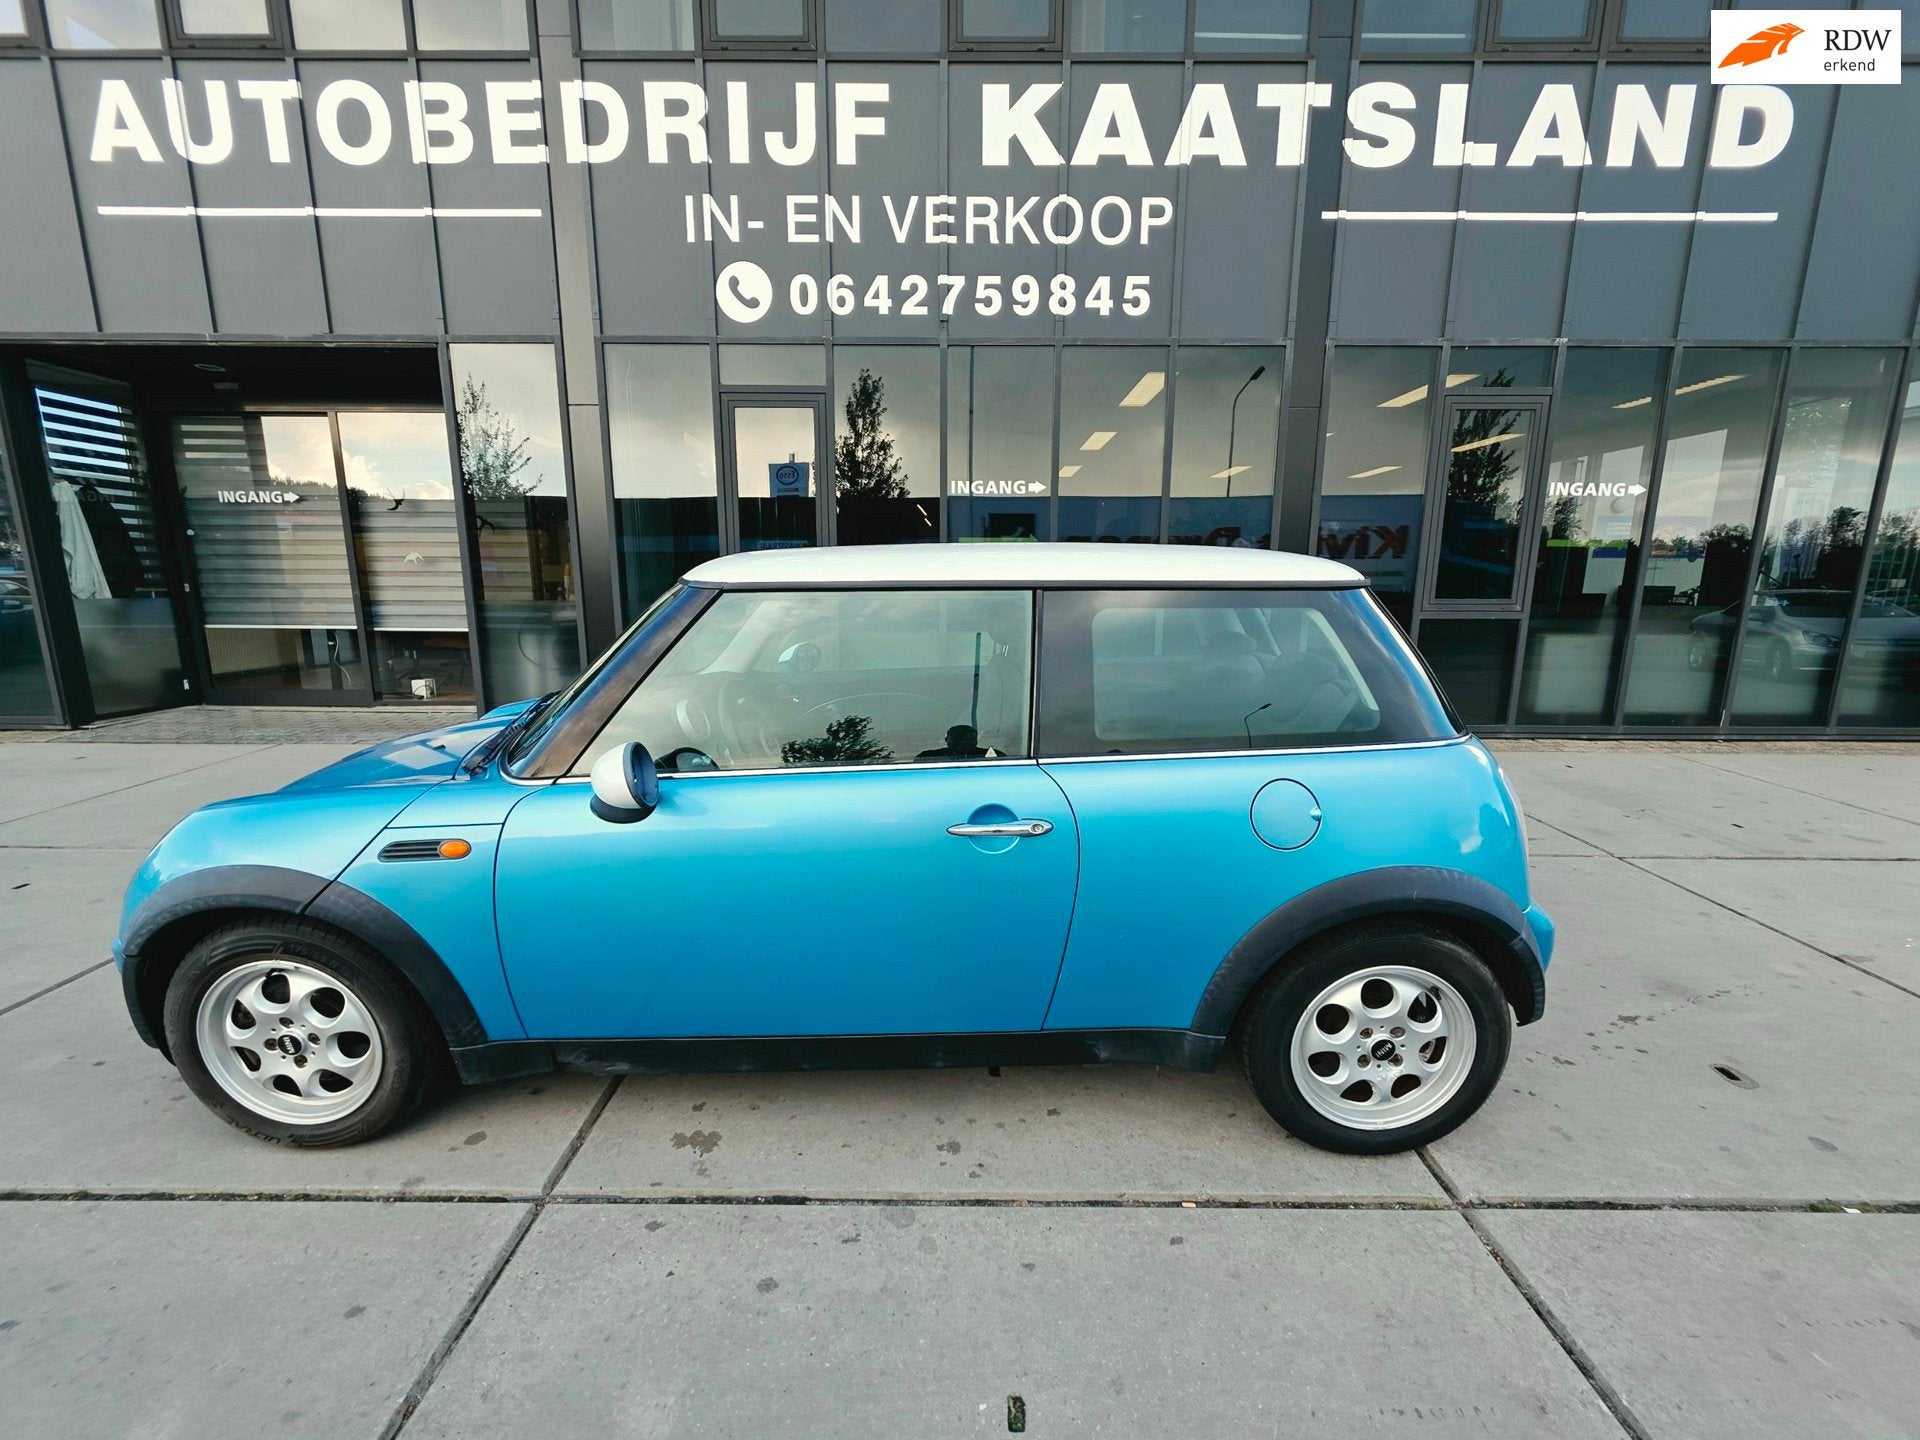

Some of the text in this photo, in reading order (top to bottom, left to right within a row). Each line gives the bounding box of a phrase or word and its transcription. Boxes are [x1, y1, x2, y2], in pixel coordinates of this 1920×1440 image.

[90, 78, 1795, 168] AUTOBEDRIJF KAATSLAND
[685, 194, 1173, 245] IN- EN VERKOOP
[789, 273, 1151, 317] 0642759845
[950, 480, 1026, 495] INGANG
[1549, 481, 1626, 497] INGANG
[217, 490, 283, 504] INGANG
[282, 1036, 296, 1054] MINI
[1375, 1042, 1392, 1057] MINI
